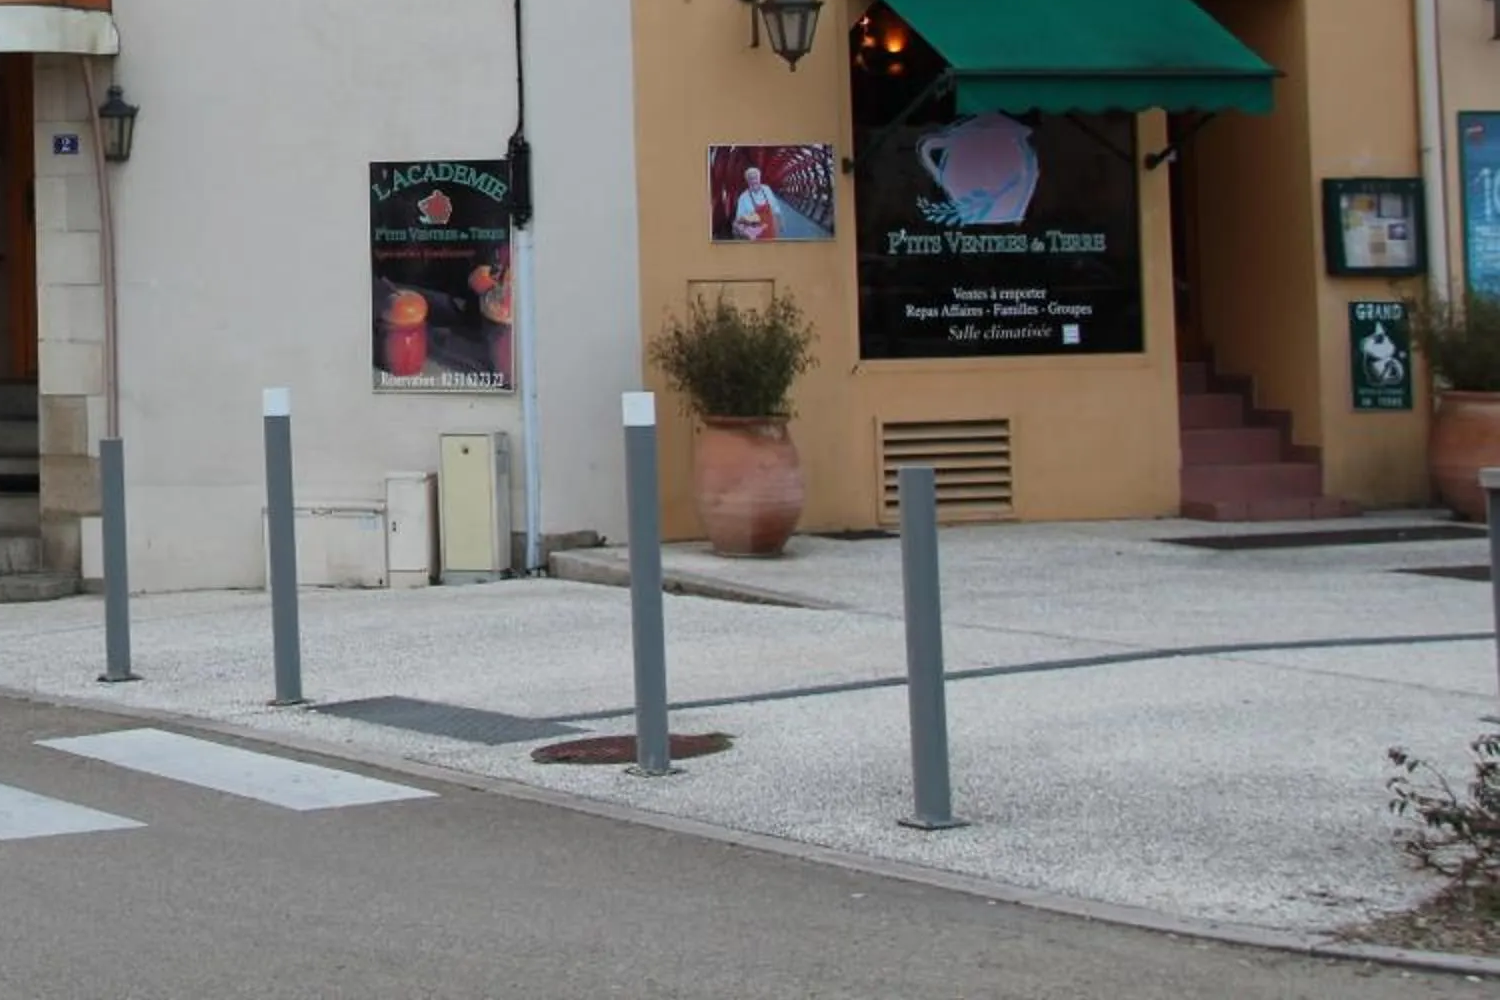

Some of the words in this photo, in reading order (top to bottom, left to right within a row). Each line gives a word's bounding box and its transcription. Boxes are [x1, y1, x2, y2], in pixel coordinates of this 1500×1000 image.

[999, 288, 1047, 304] emporter
[905, 303, 939, 320] Repas
[940, 303, 984, 317] Affaires
[993, 302, 1039, 317] Familles
[1047, 301, 1093, 318] Groupes
[947, 323, 981, 341] Salle
[982, 322, 1053, 340] climatisée
